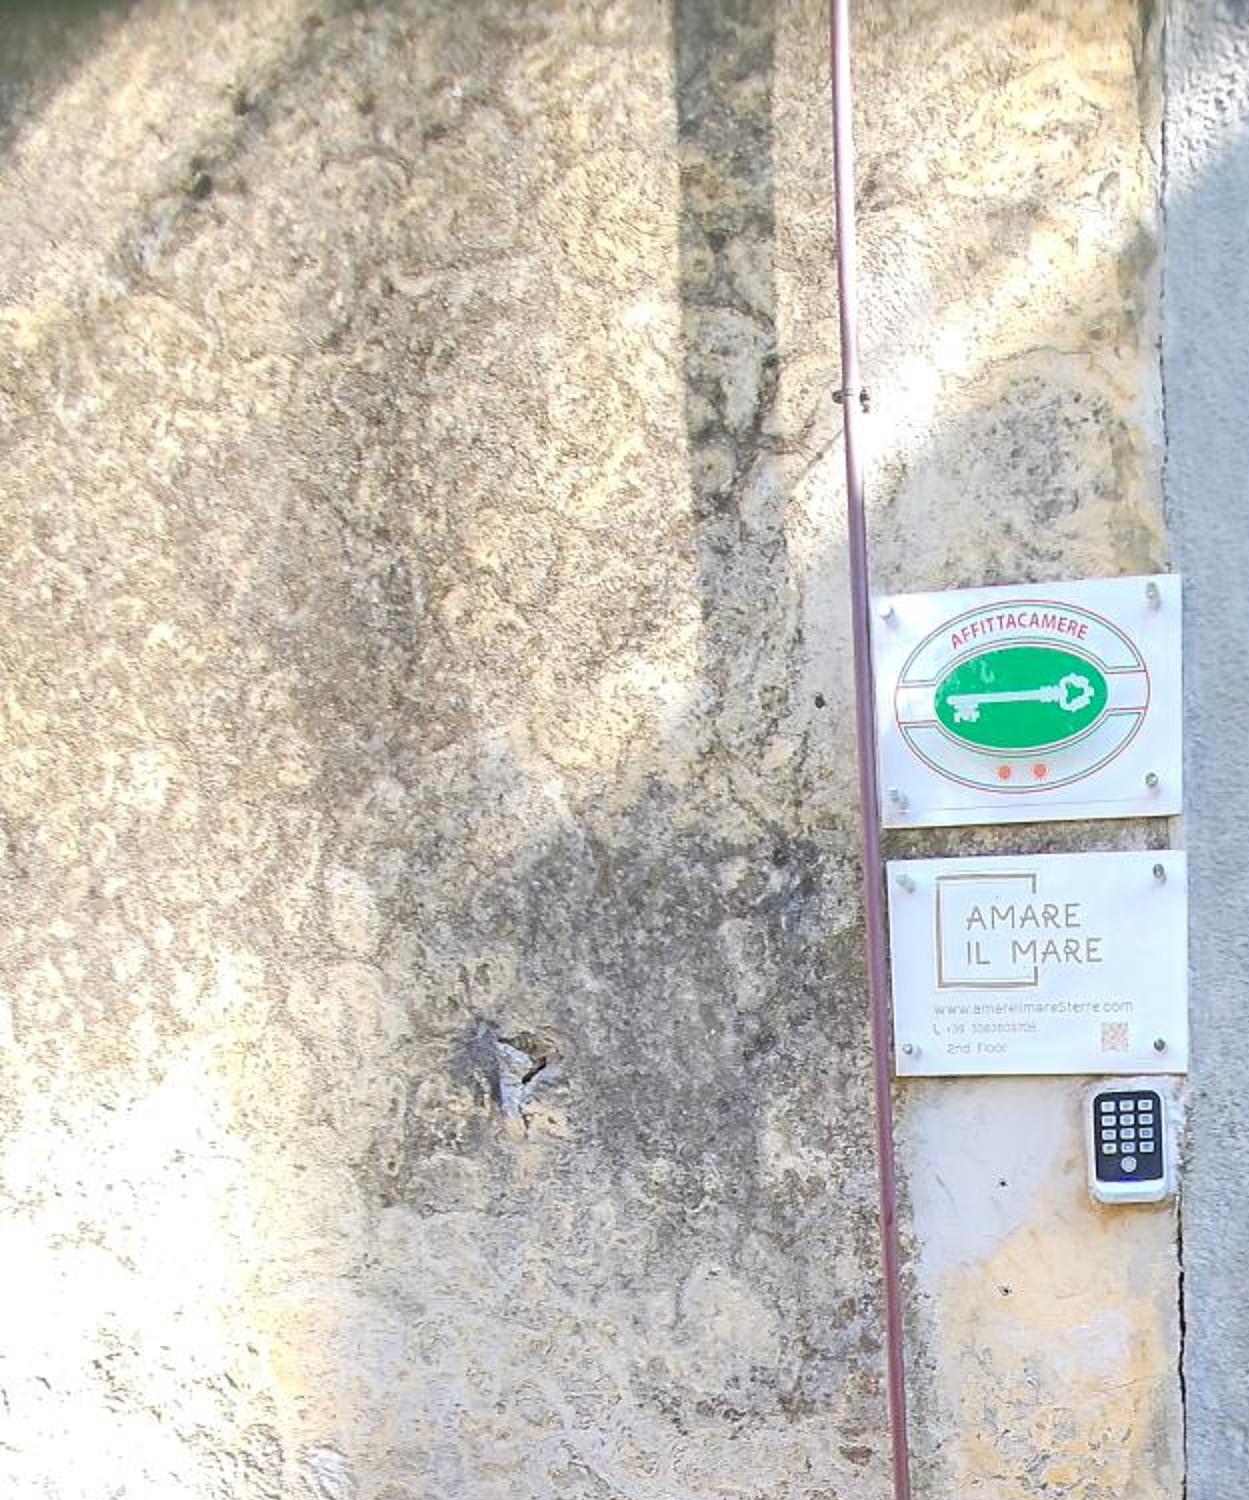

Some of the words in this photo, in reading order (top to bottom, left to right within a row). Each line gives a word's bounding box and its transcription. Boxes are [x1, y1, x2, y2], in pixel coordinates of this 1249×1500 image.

[951, 612, 1089, 649] AFFITTACAMERE
[966, 903, 1081, 930] AMARE
[966, 940, 991, 965] IL
[1012, 937, 1103, 964] MARE
